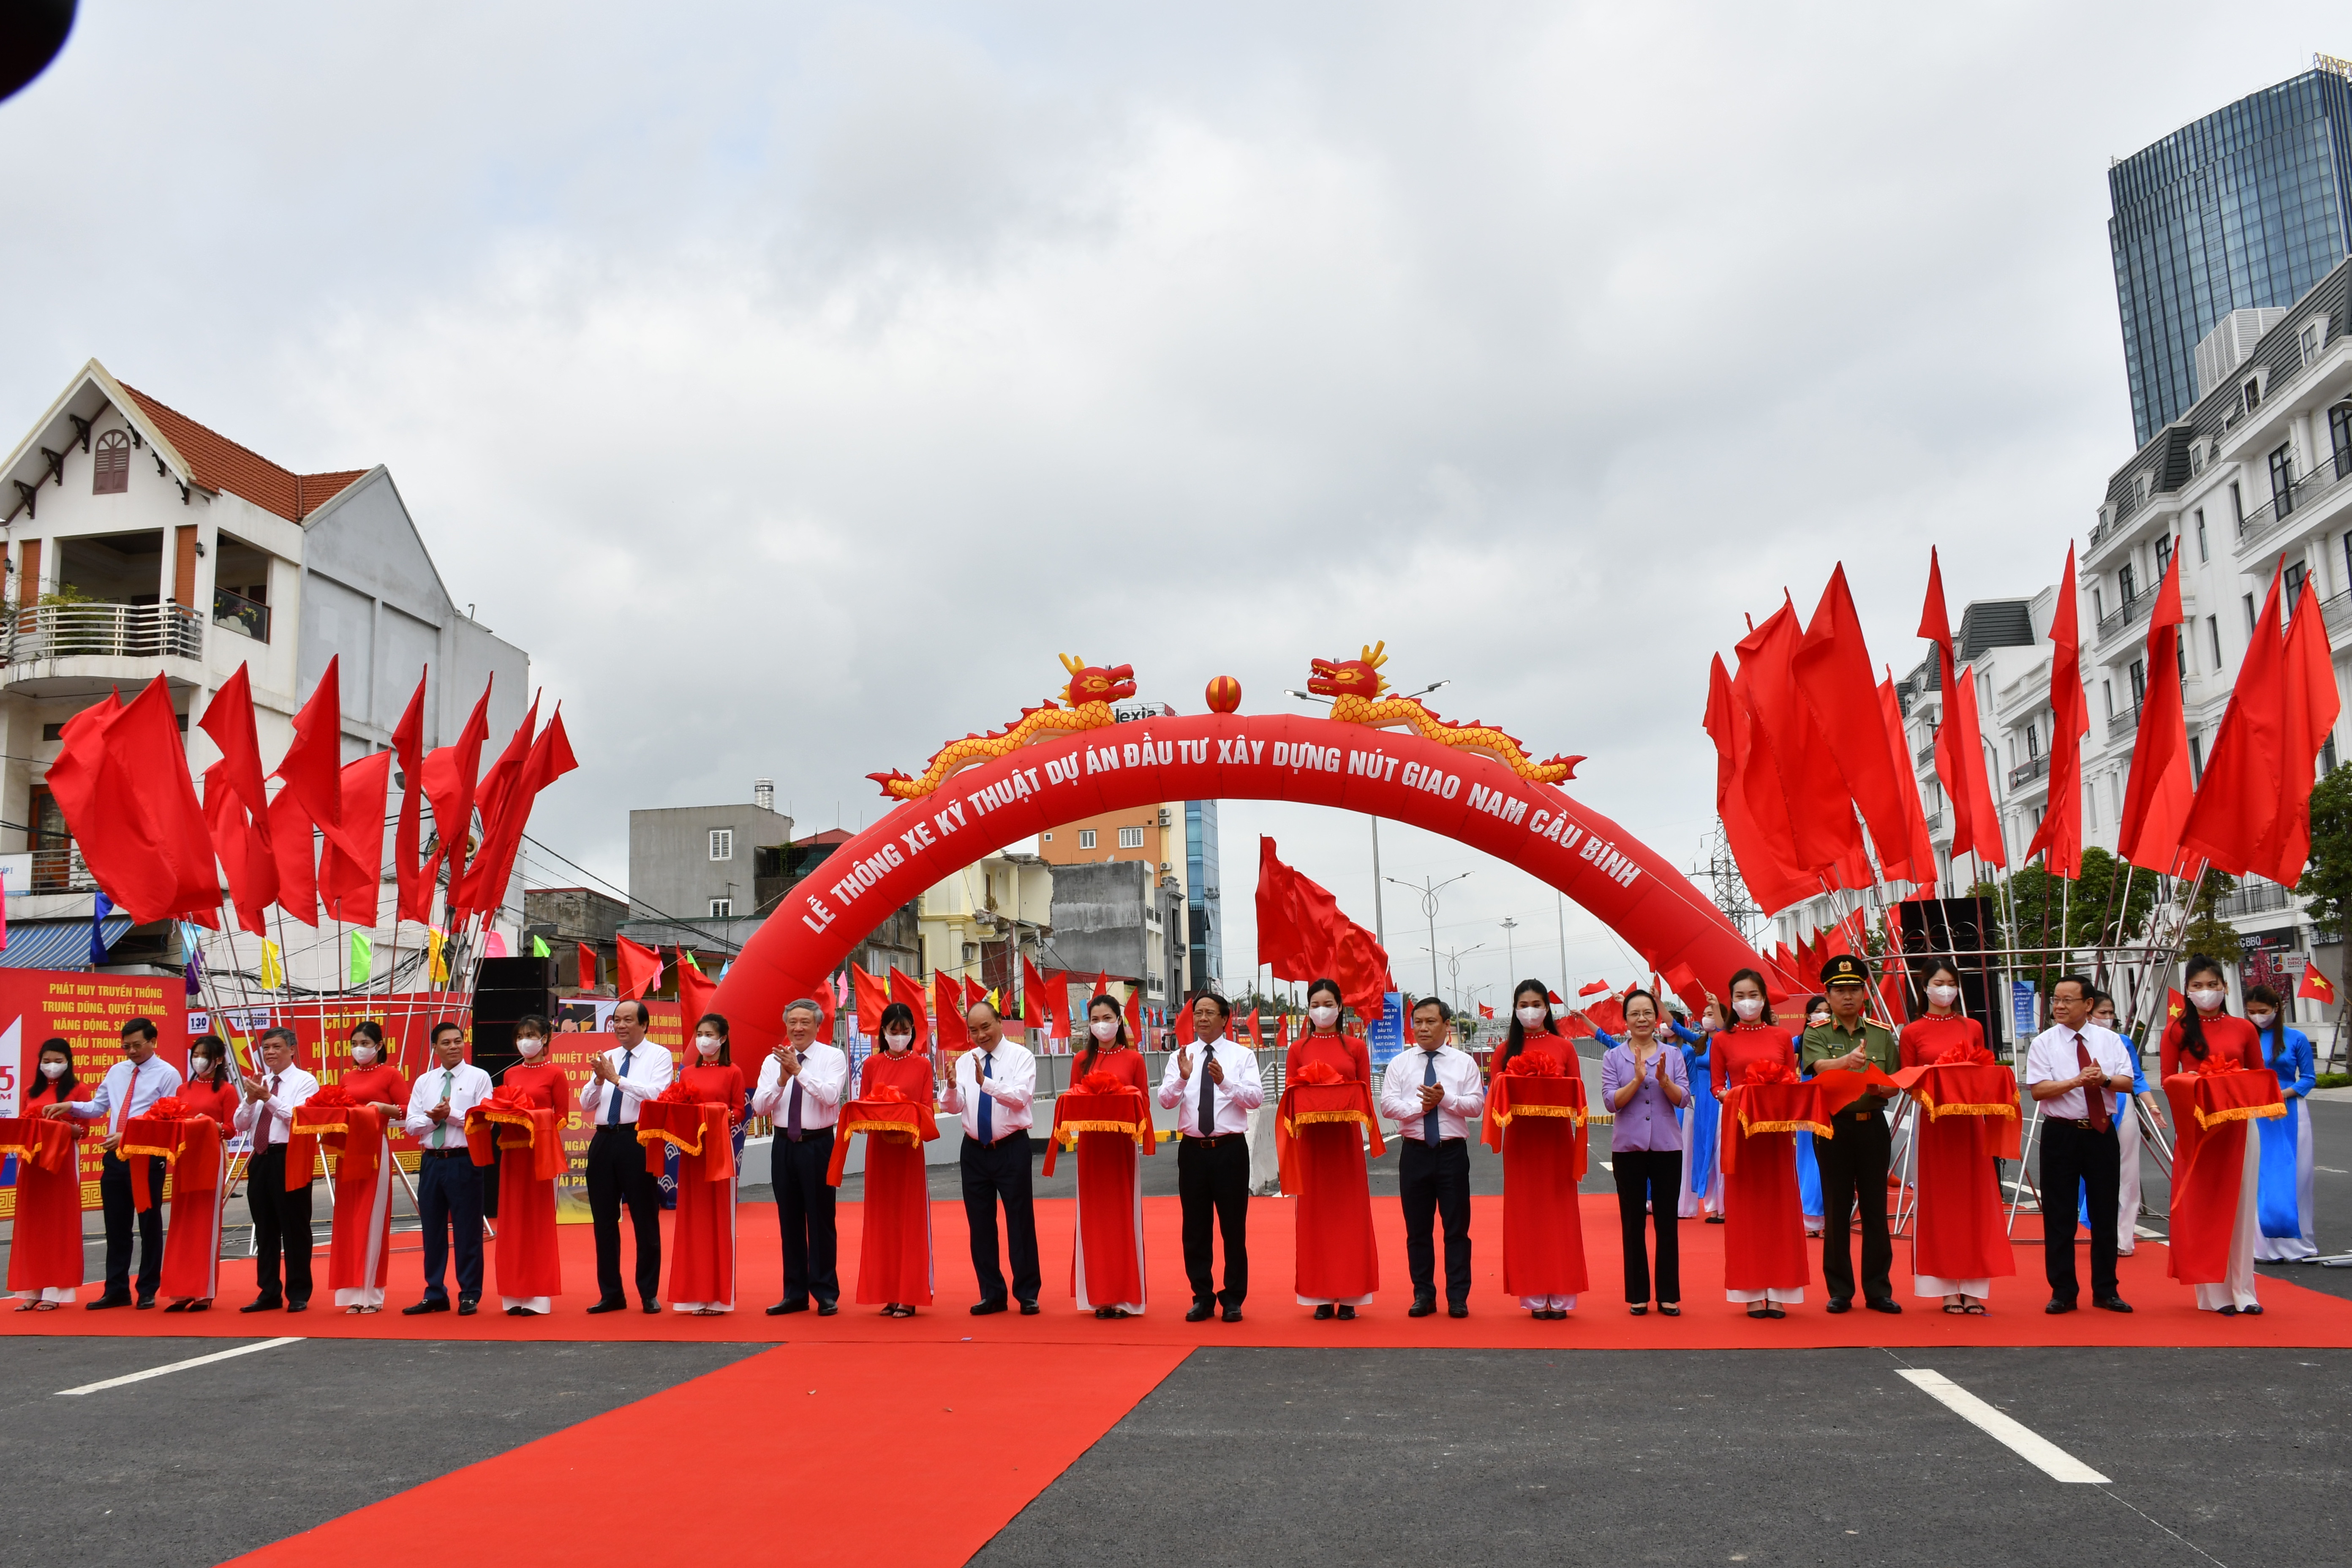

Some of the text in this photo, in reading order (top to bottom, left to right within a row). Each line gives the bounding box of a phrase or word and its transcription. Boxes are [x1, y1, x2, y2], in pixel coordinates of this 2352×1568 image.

[1116, 706, 1156, 723] lexia
[802, 732, 1642, 934] LỄ THÔNG XE KỸ THUẬT DỰ ÁN ĐẦU TƯ XÂY DỰNG NÚT GIAO NAM CẦU BÍNH
[49, 982, 162, 998] PHÁT HUY TRUYỀN THỐNG
[42, 1001, 168, 1016] TRUNG DŨNG, QUYẾT THẮNG,
[53, 1018, 80, 1030] NĂNG
[83, 1018, 111, 1032] ĐỘNG,
[191, 1017, 207, 1027] 130
[70, 1034, 89, 1048] ĐẦU
[334, 1040, 351, 1057] CH
[73, 1054, 90, 1068] HỰC
[93, 1054, 111, 1069] HIỆN
[553, 1051, 583, 1065] NHIỆT
[83, 1070, 107, 1084] QUYẾ
[559, 1174, 568, 1187] ẢI
